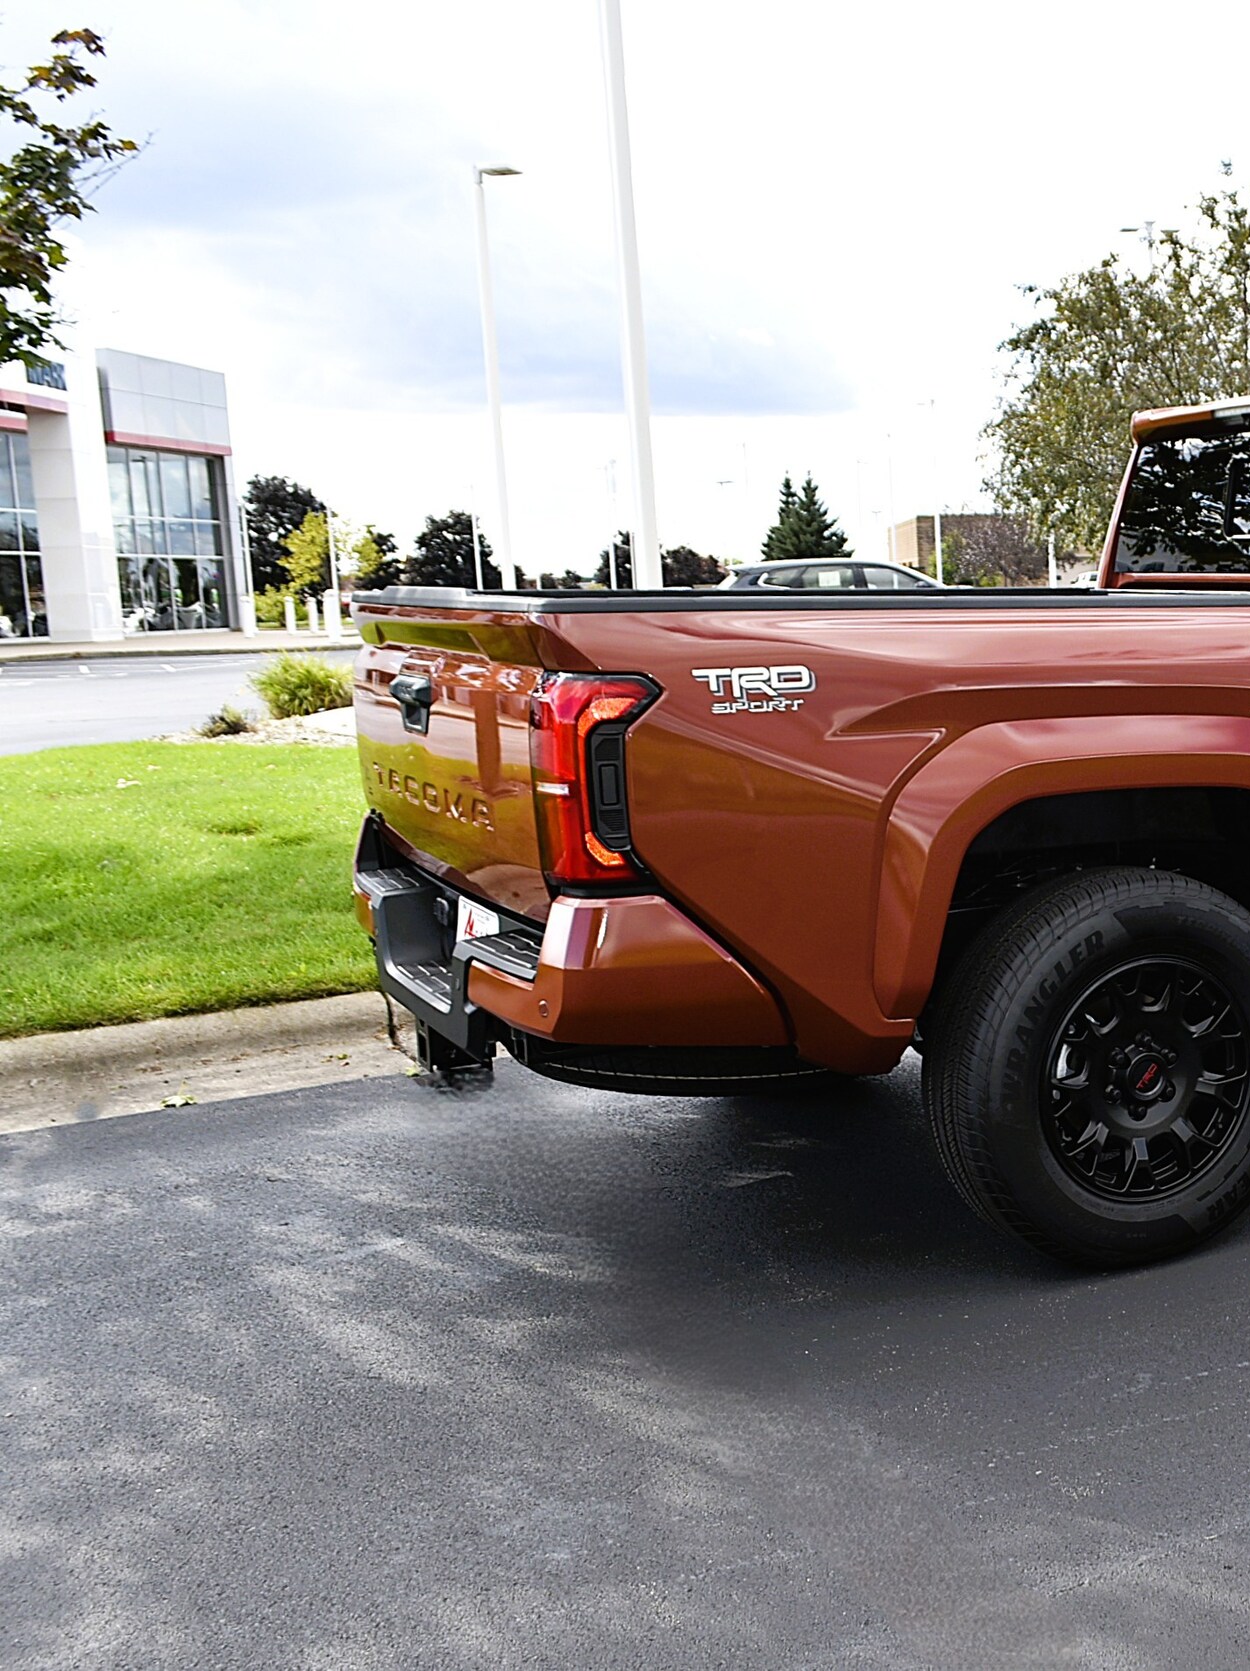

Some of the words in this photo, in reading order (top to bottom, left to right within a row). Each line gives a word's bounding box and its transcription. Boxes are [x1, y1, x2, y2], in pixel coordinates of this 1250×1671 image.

[691, 665, 816, 697] TRD
[711, 699, 804, 714] SPORT
[372, 761, 495, 831] TACOMA
[1002, 928, 1106, 1103] WRANGLER
[1136, 1062, 1158, 1089] TRD
